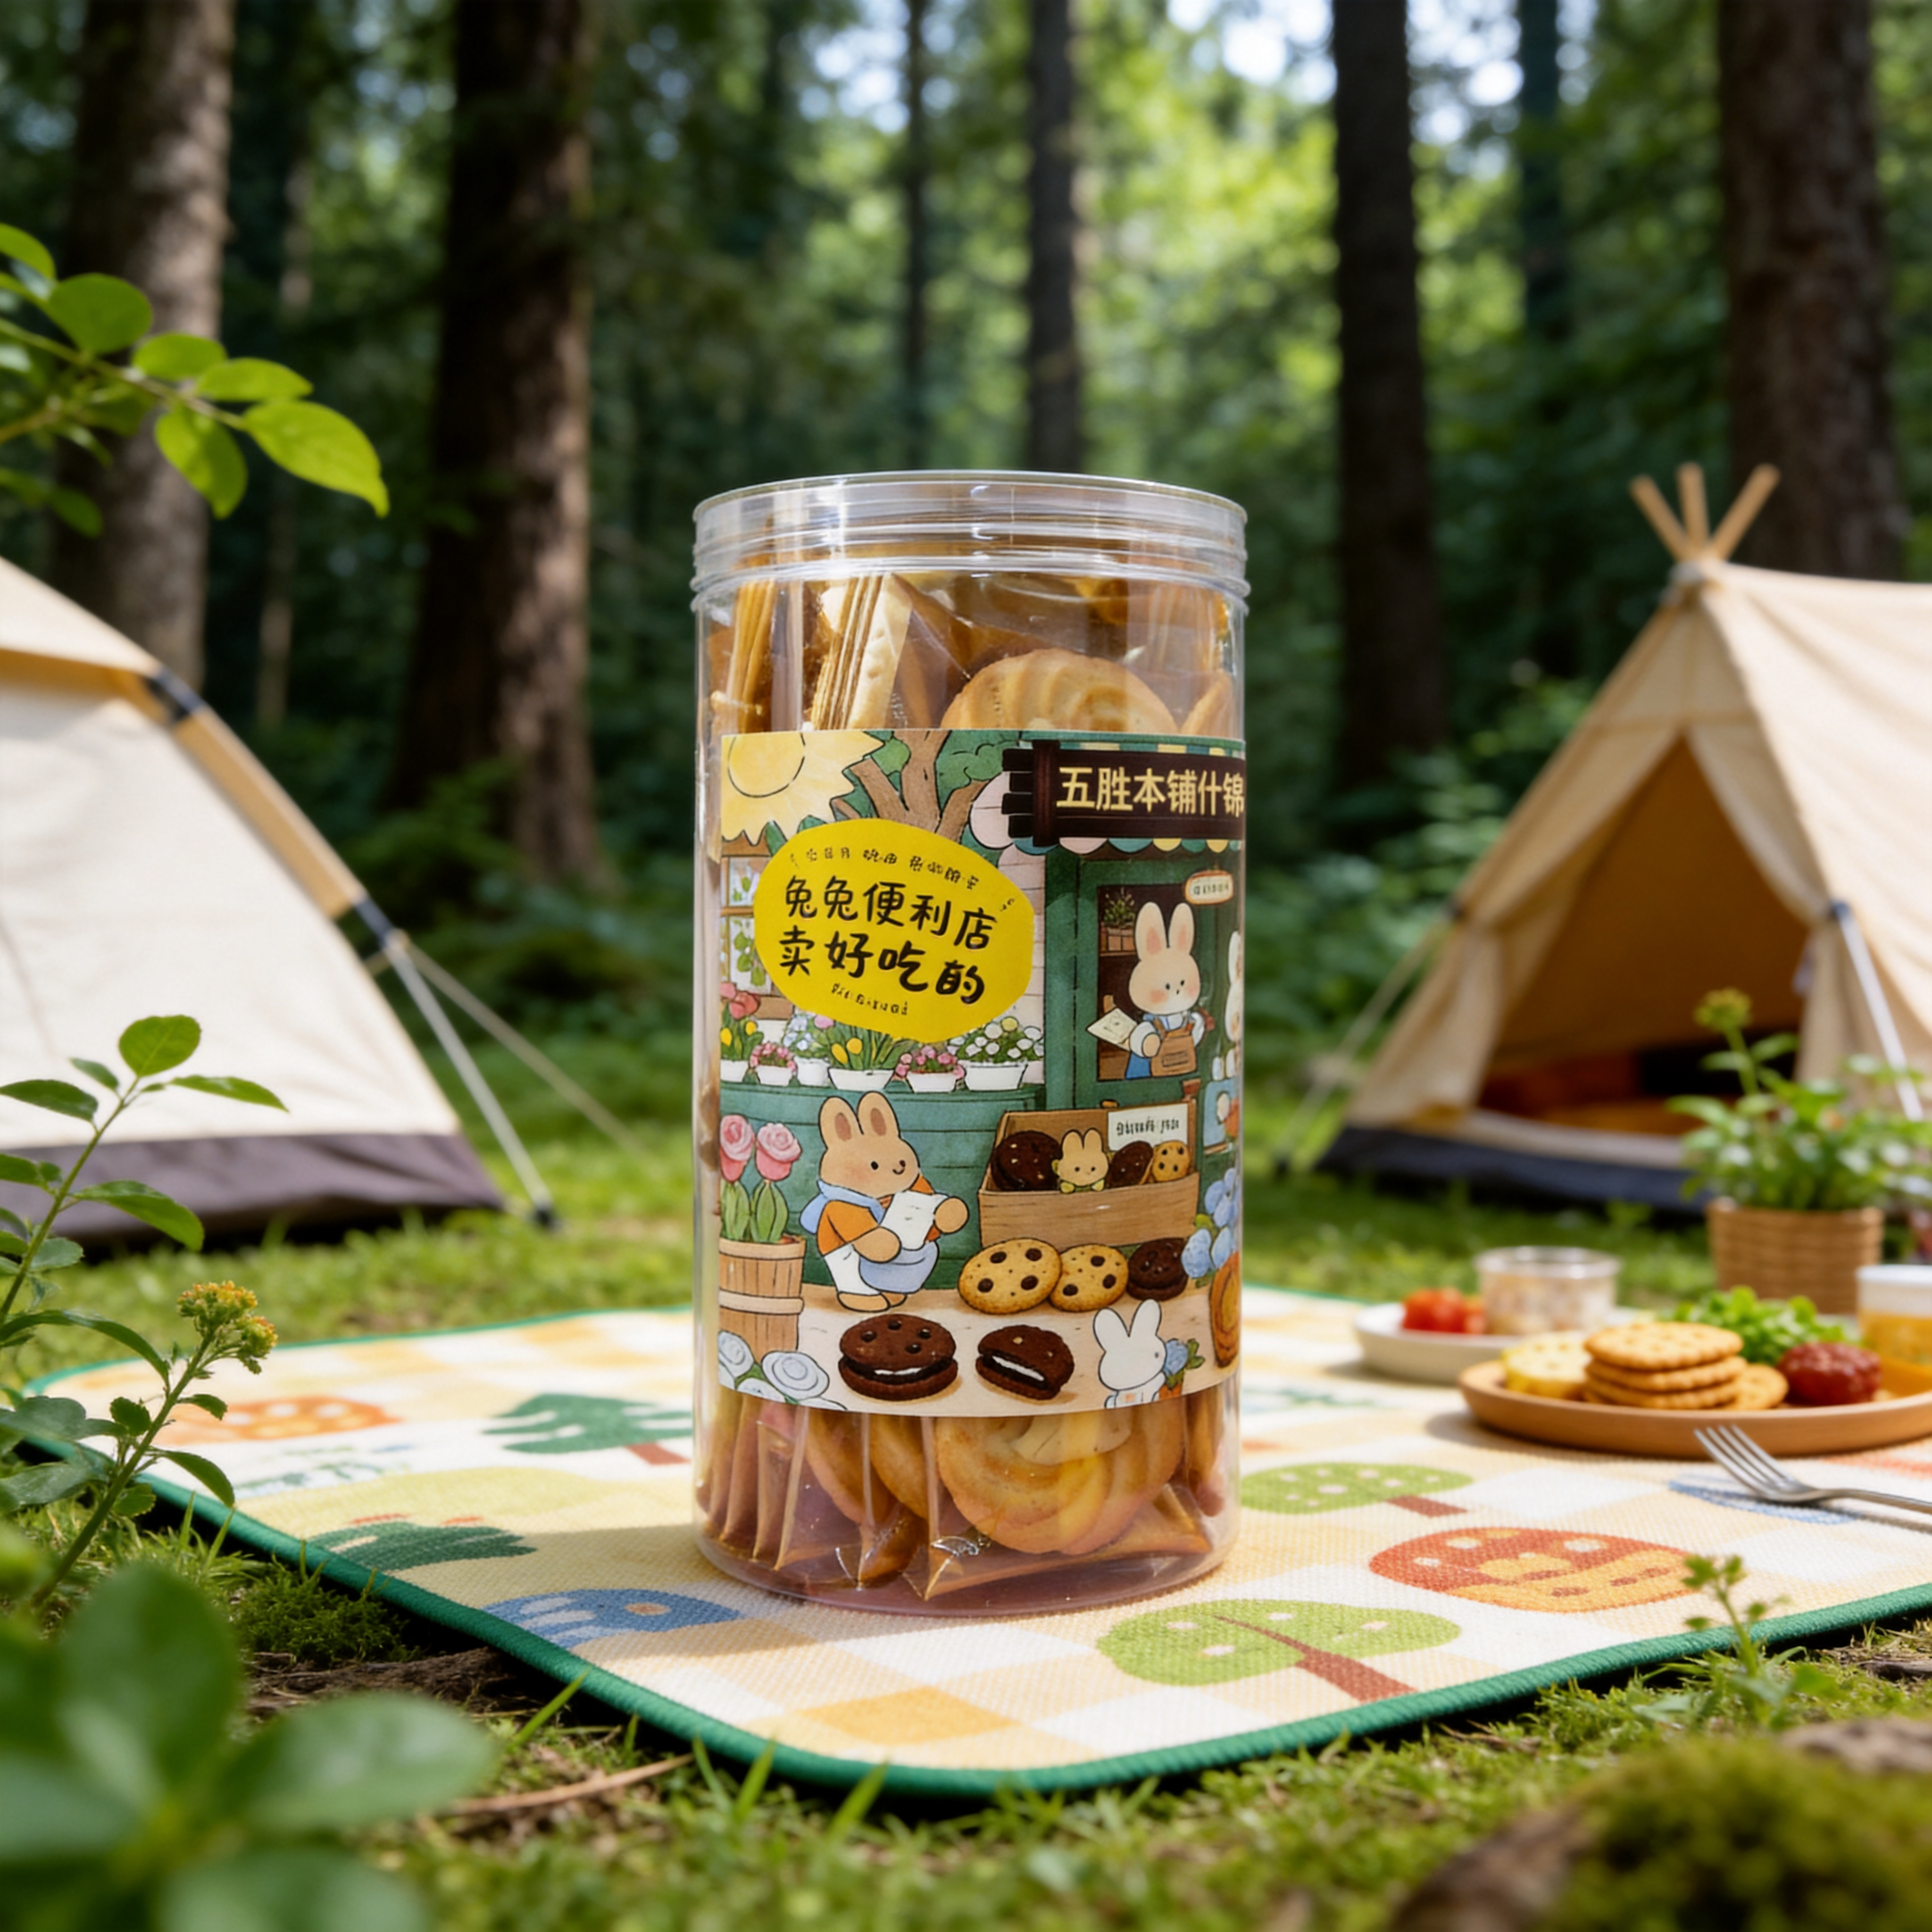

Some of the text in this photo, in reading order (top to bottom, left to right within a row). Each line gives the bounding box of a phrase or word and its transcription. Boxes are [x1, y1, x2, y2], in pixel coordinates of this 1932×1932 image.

[1057, 766, 1245, 818] 五胜本铺什锦
[785, 875, 997, 949] 兔兔便利店
[779, 925, 985, 1004] 卖好吃的
